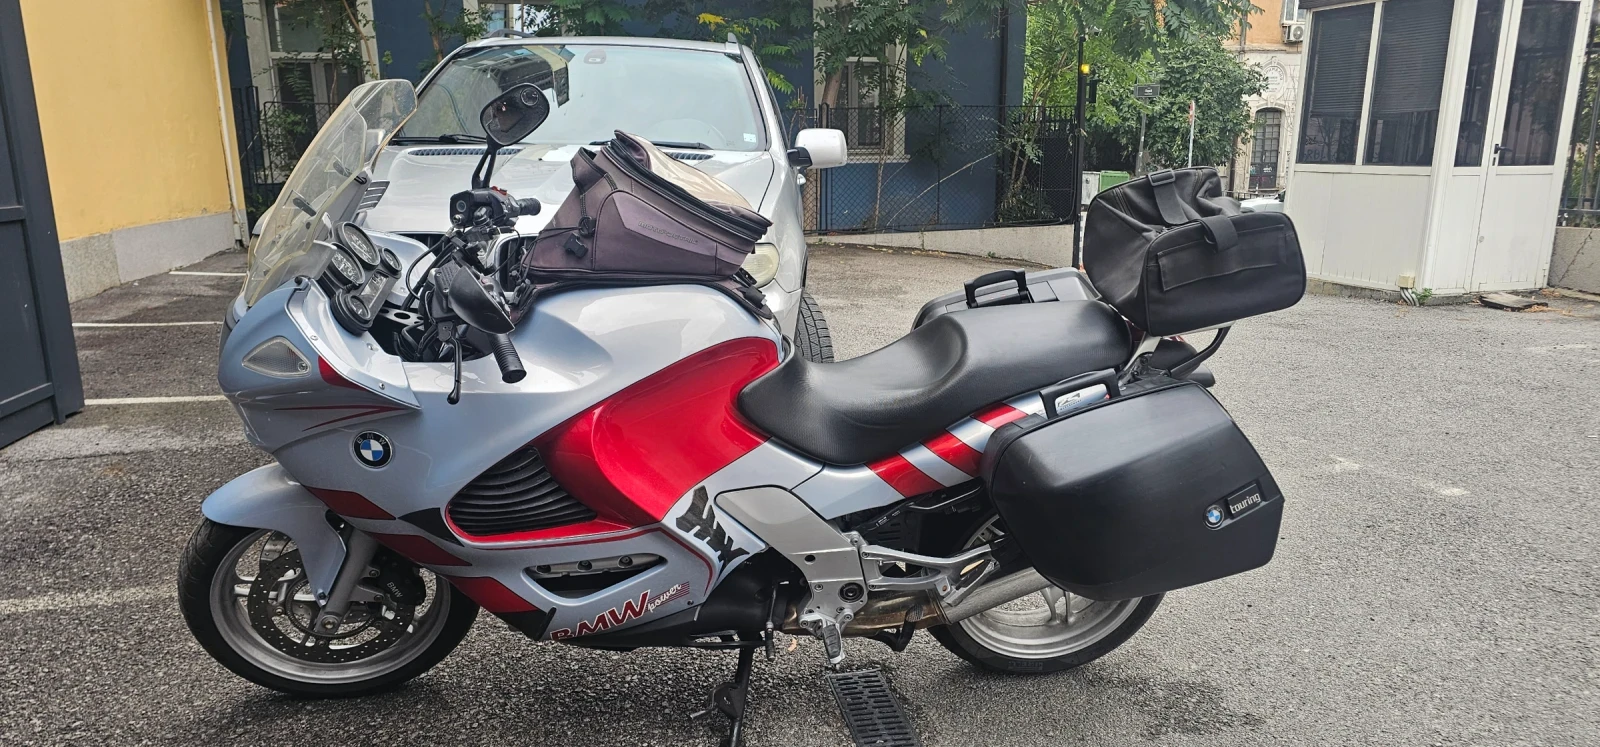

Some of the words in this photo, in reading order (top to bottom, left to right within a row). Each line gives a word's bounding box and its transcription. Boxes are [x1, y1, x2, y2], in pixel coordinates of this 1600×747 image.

[1229, 493, 1261, 514] touring
[387, 582, 403, 597] BMW
[550, 589, 650, 640] BMW
